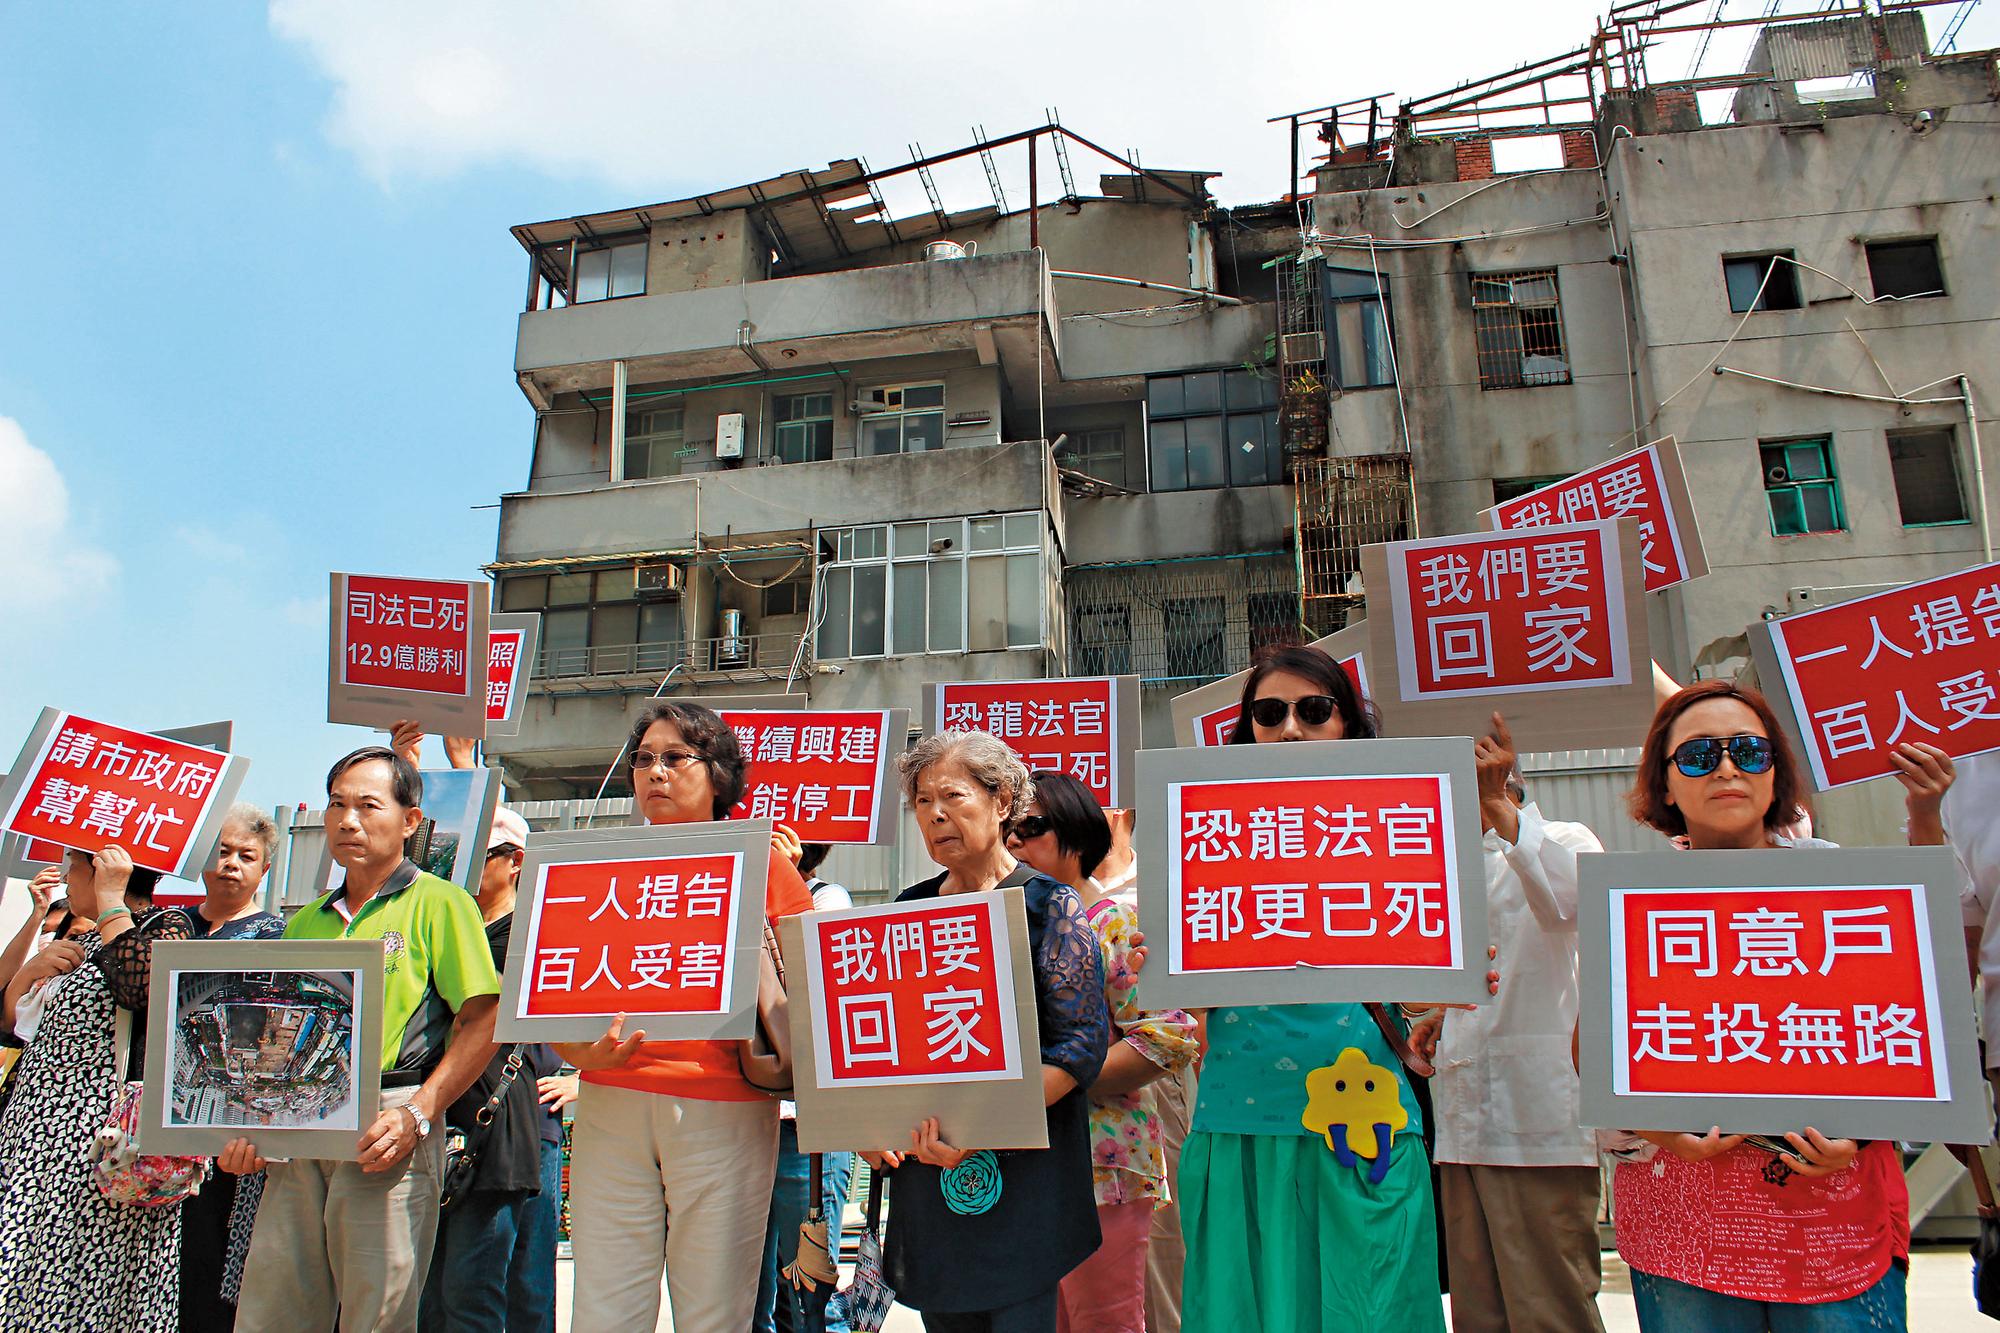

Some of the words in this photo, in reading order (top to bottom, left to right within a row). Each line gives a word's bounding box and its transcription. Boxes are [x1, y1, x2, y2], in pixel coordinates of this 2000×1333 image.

[1419, 539, 1589, 607] 我們要
[348, 590, 465, 632] 司法已死
[1427, 601, 1597, 685] 回家
[347, 642, 463, 676] 12.9億勝利
[945, 698, 1106, 738] 恐龍法官
[49, 727, 217, 800] 請市政府
[31, 776, 185, 853] 幫幫忙
[735, 783, 871, 822] 能停工
[1182, 803, 1437, 864] 恐龍法官
[544, 872, 730, 922] 一人提告
[1184, 881, 1446, 944] 都更已死
[536, 940, 723, 994] 百人受害
[829, 914, 980, 986] 我們要
[1645, 905, 1895, 979] 同意戶
[838, 986, 992, 1069] 回家
[1631, 1001, 1924, 1067] 走投無路
